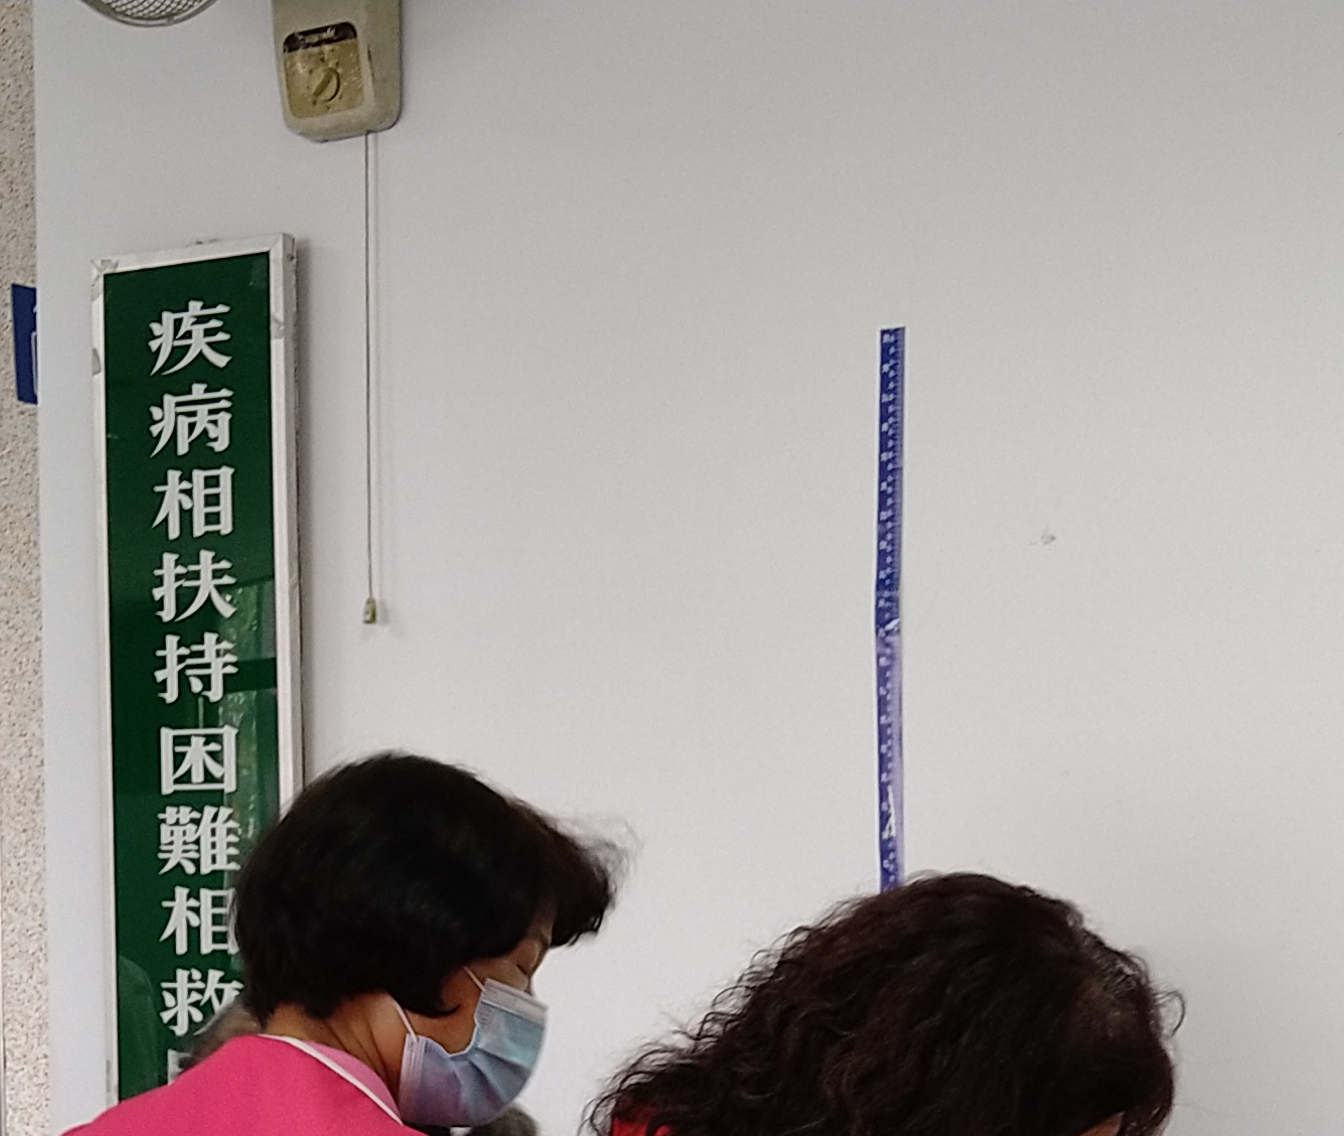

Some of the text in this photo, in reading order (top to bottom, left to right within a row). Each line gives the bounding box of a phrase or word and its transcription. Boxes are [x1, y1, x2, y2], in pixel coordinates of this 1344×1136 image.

[148, 300, 244, 1086] 疾病相扶持困難相救
